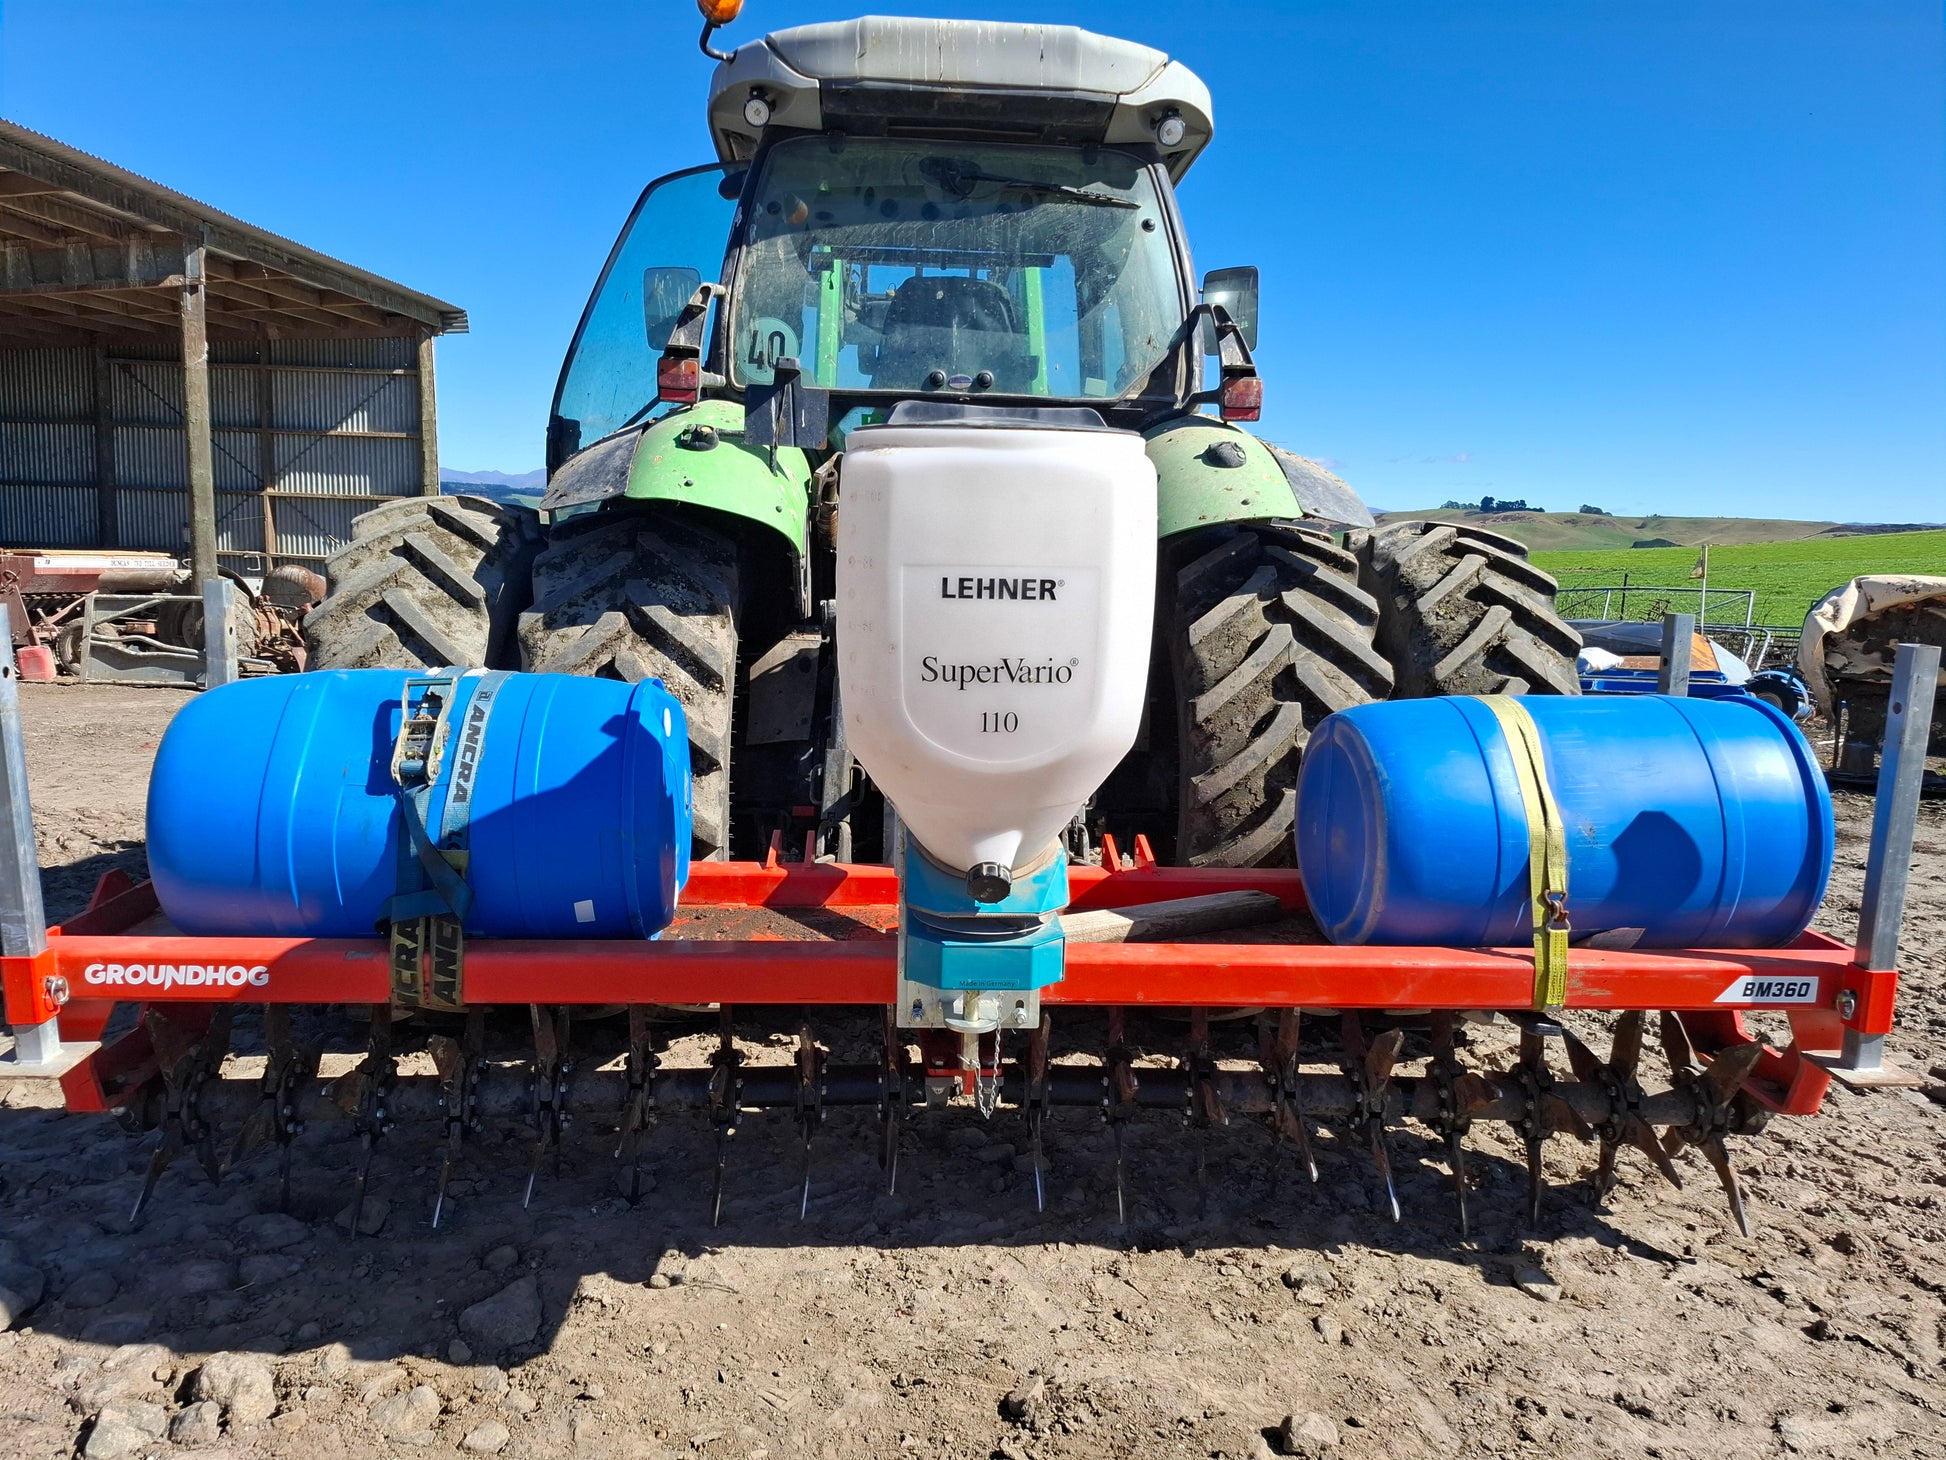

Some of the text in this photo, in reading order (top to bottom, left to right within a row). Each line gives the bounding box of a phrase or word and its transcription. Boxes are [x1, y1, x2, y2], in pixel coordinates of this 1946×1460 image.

[748, 330, 786, 370] 40
[980, 711, 1018, 733] 110
[453, 703, 485, 804] ANCRA
[84, 963, 269, 991] GROUNDHOG
[959, 979, 977, 987] Made
[987, 980, 1015, 988] Germany
[1742, 982, 1811, 998] BM360
